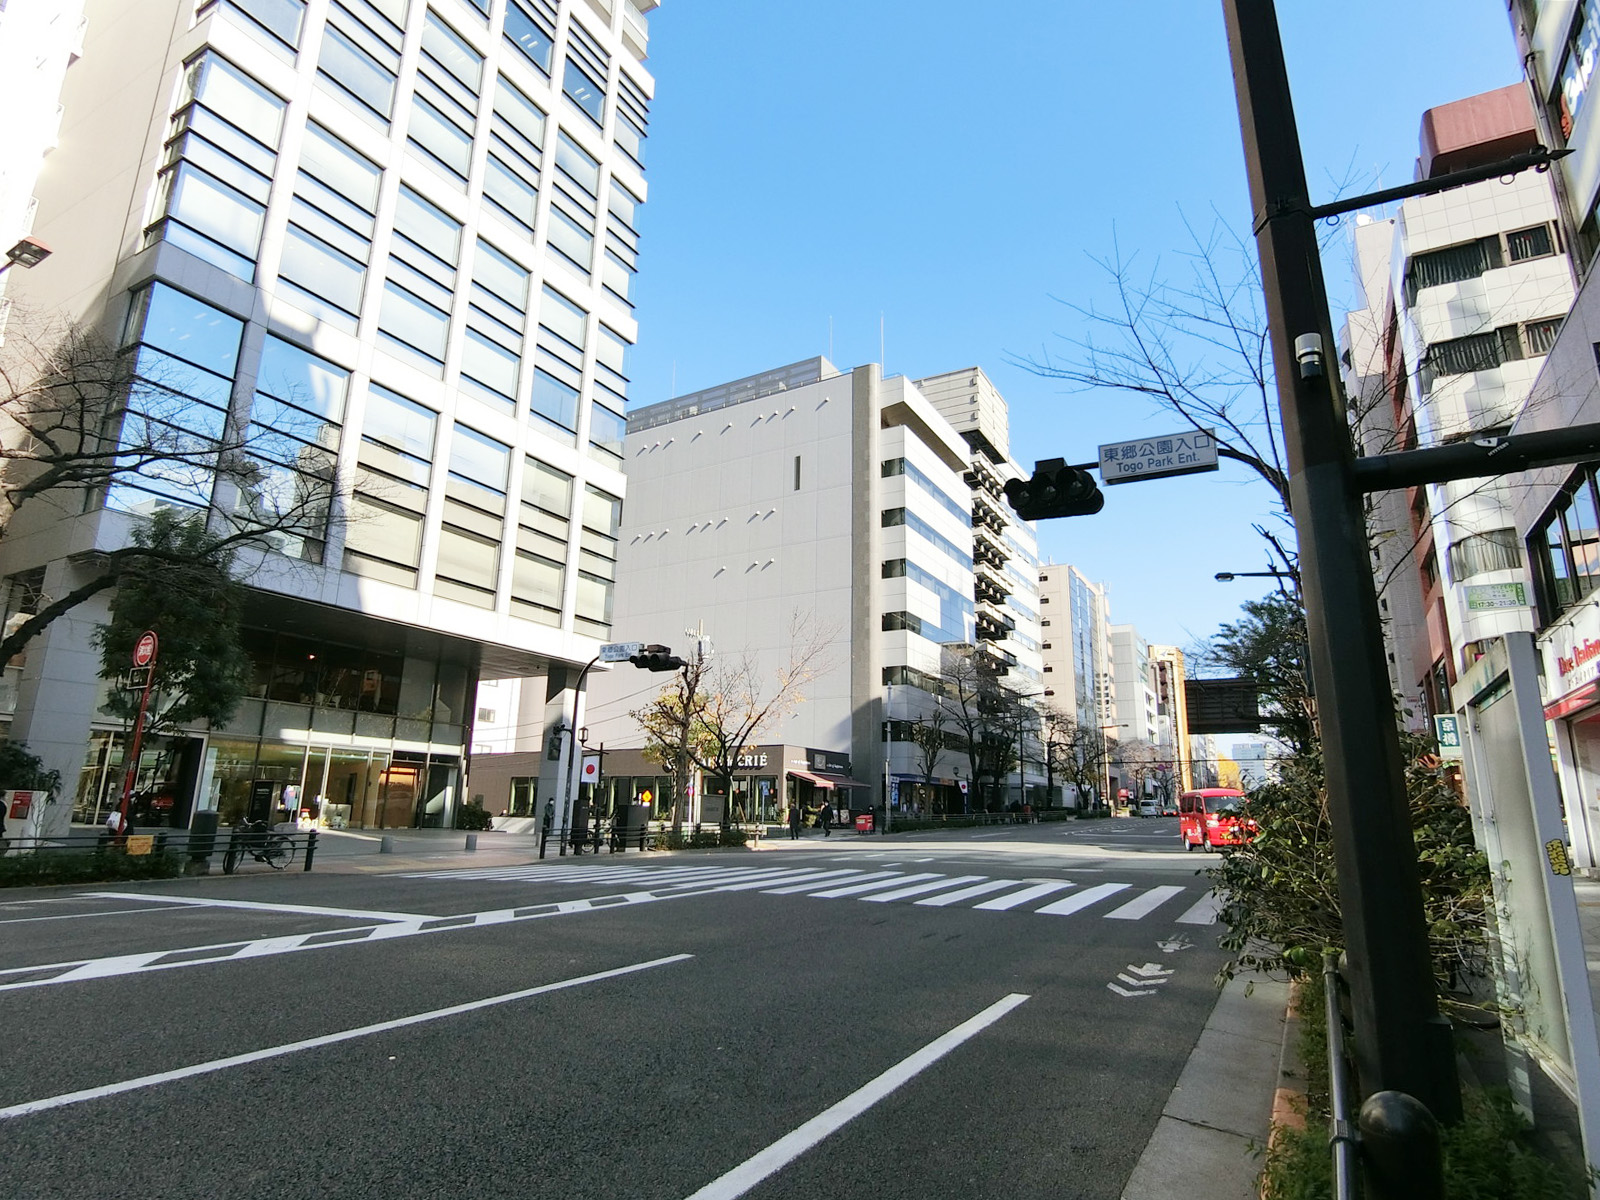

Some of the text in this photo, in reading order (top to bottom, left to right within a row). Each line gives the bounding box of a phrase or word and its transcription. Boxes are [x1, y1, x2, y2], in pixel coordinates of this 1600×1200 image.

[1103, 435, 1210, 462] 東郷公園入口
[1116, 451, 1200, 473] Togo Park Ent.
